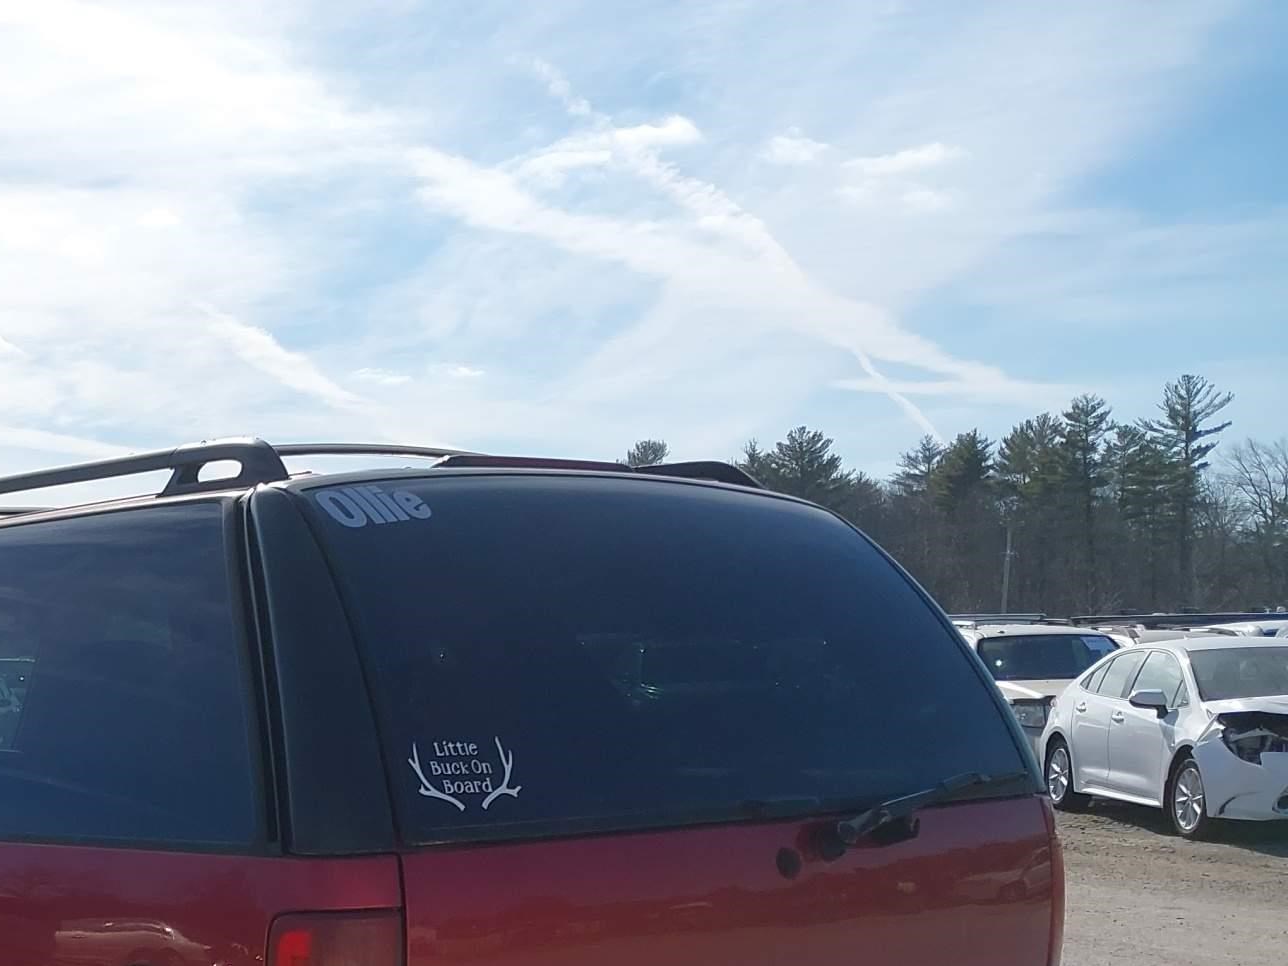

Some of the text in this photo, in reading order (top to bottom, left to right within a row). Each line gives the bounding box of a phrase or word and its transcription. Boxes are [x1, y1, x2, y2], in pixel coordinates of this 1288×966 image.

[315, 485, 432, 528] Ollie
[433, 740, 479, 756] Little
[430, 759, 493, 775] Buck On
[443, 777, 493, 794] Board
